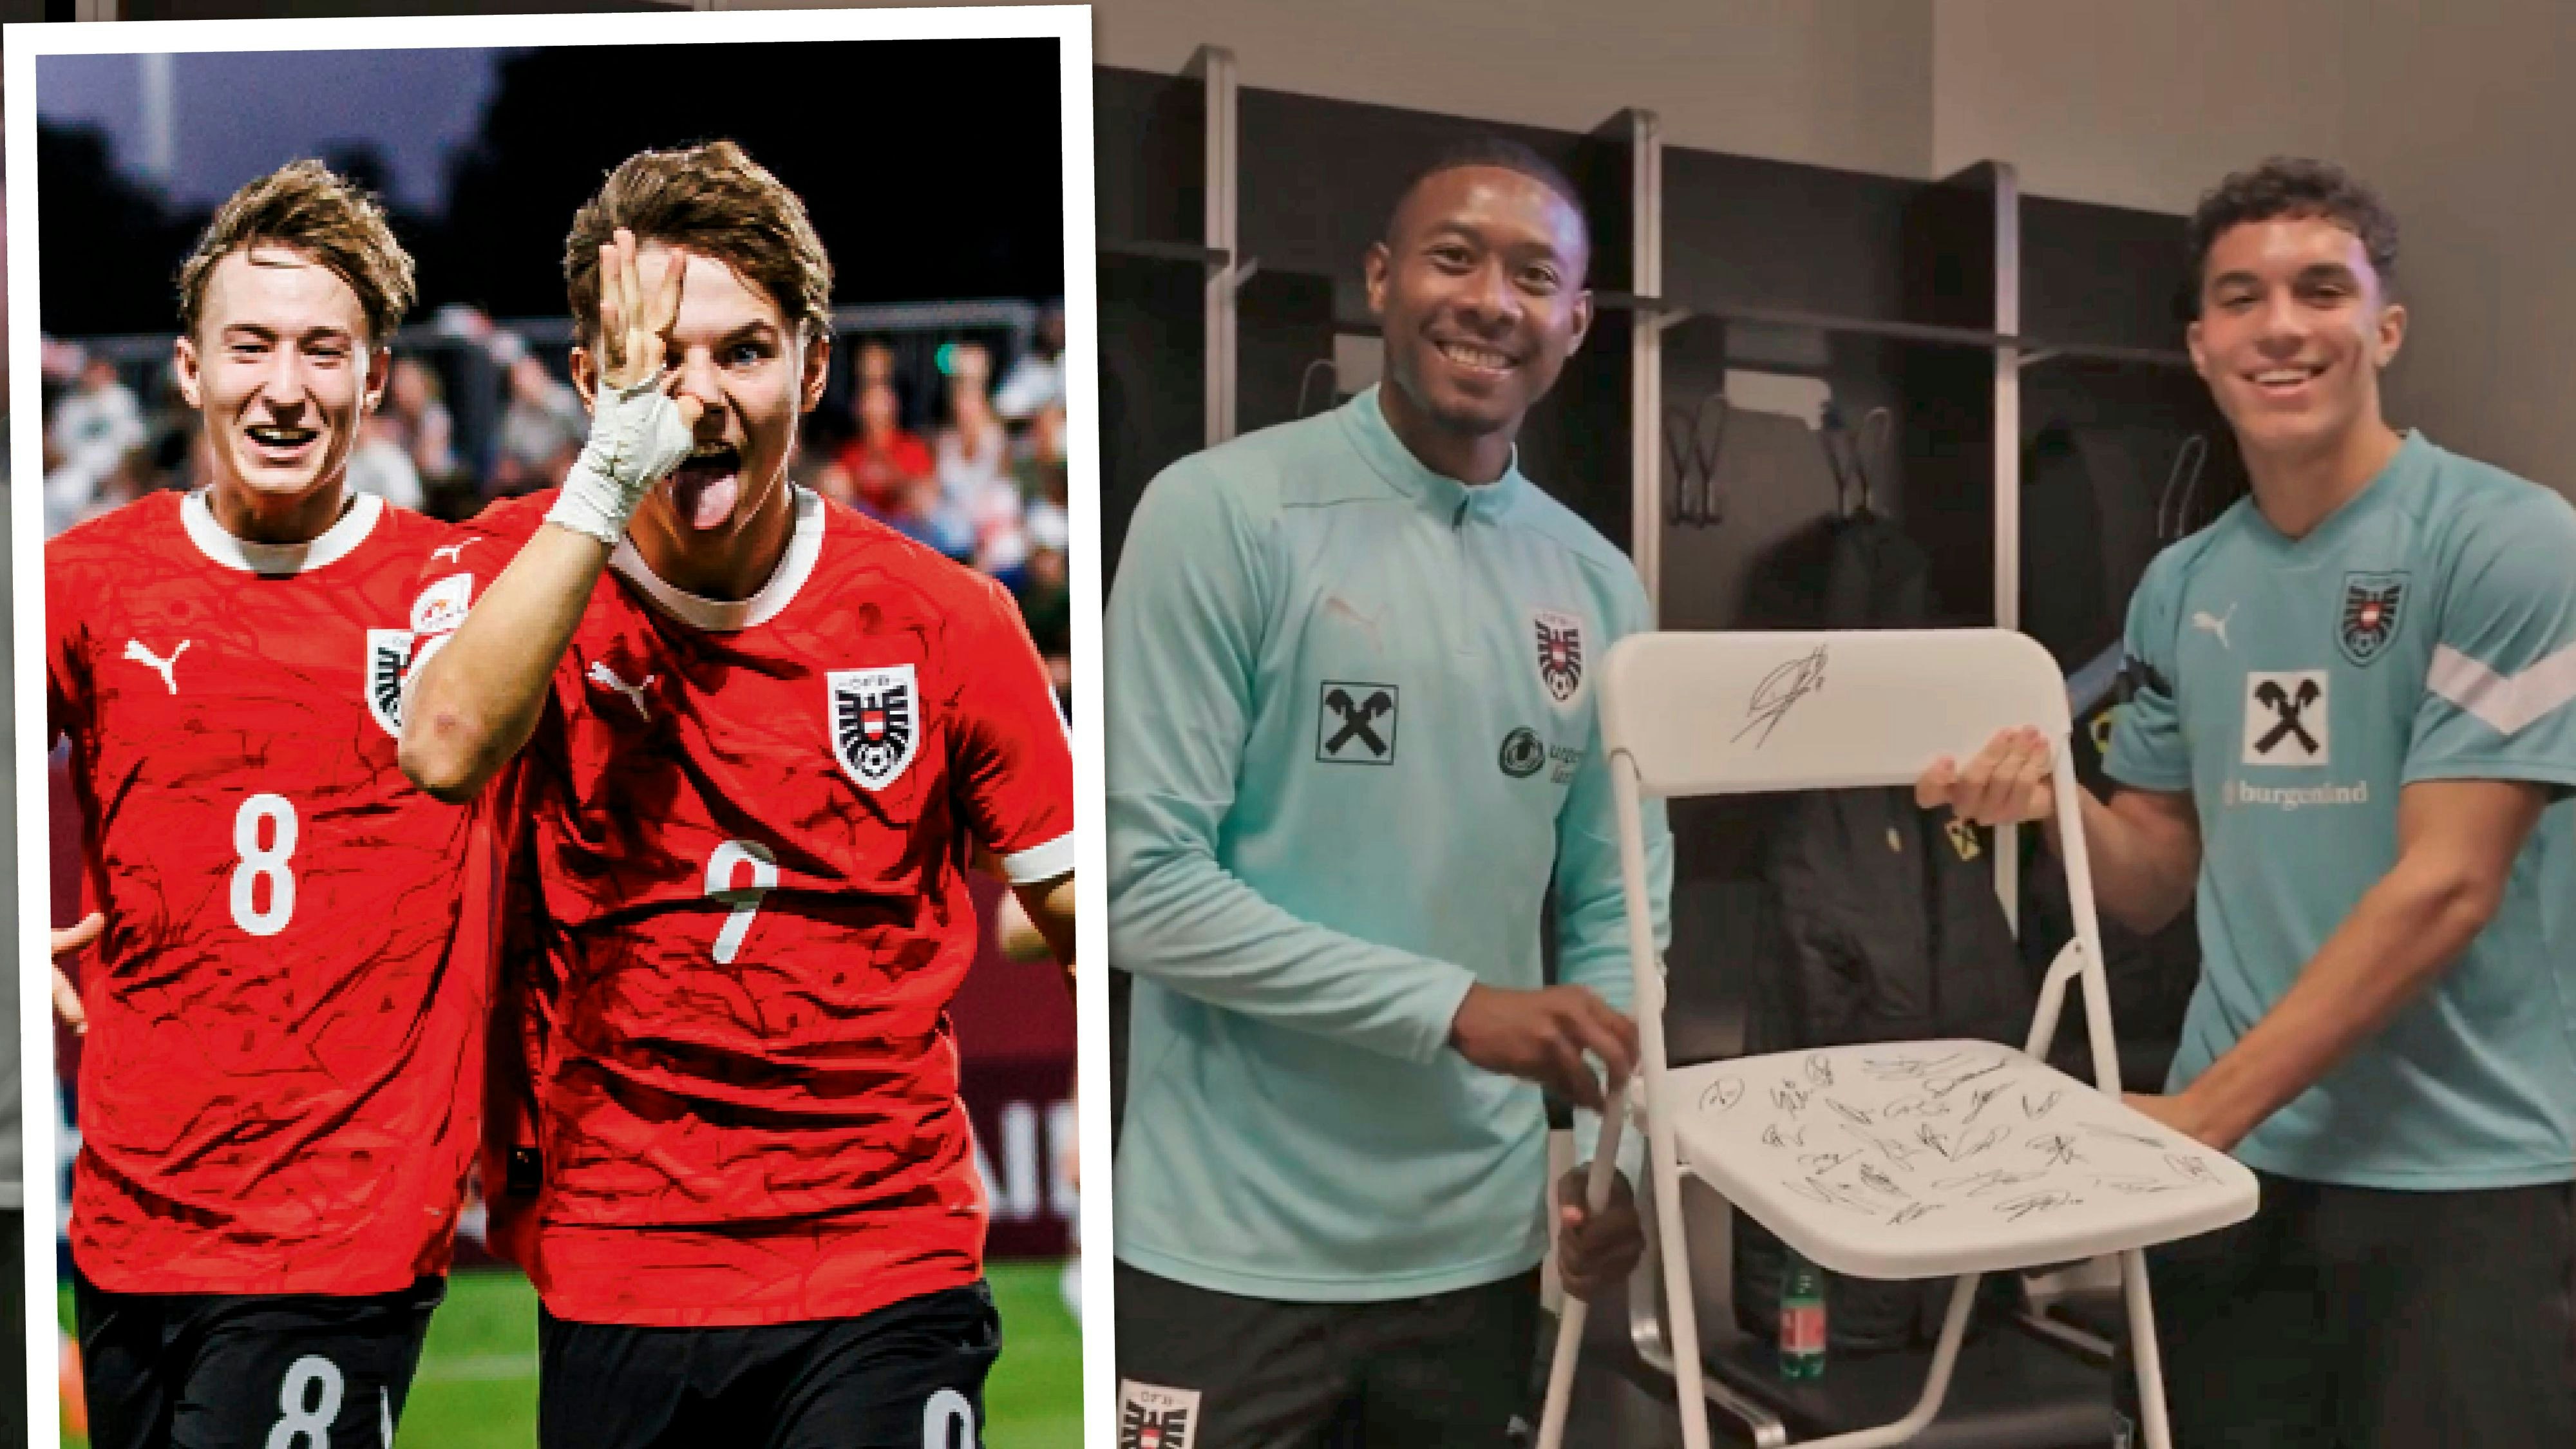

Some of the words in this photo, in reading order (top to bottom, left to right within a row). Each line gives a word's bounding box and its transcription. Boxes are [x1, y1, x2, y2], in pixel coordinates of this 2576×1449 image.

[230, 793, 298, 936] 8
[705, 840, 779, 963] 9
[265, 1354, 345, 1449] 8
